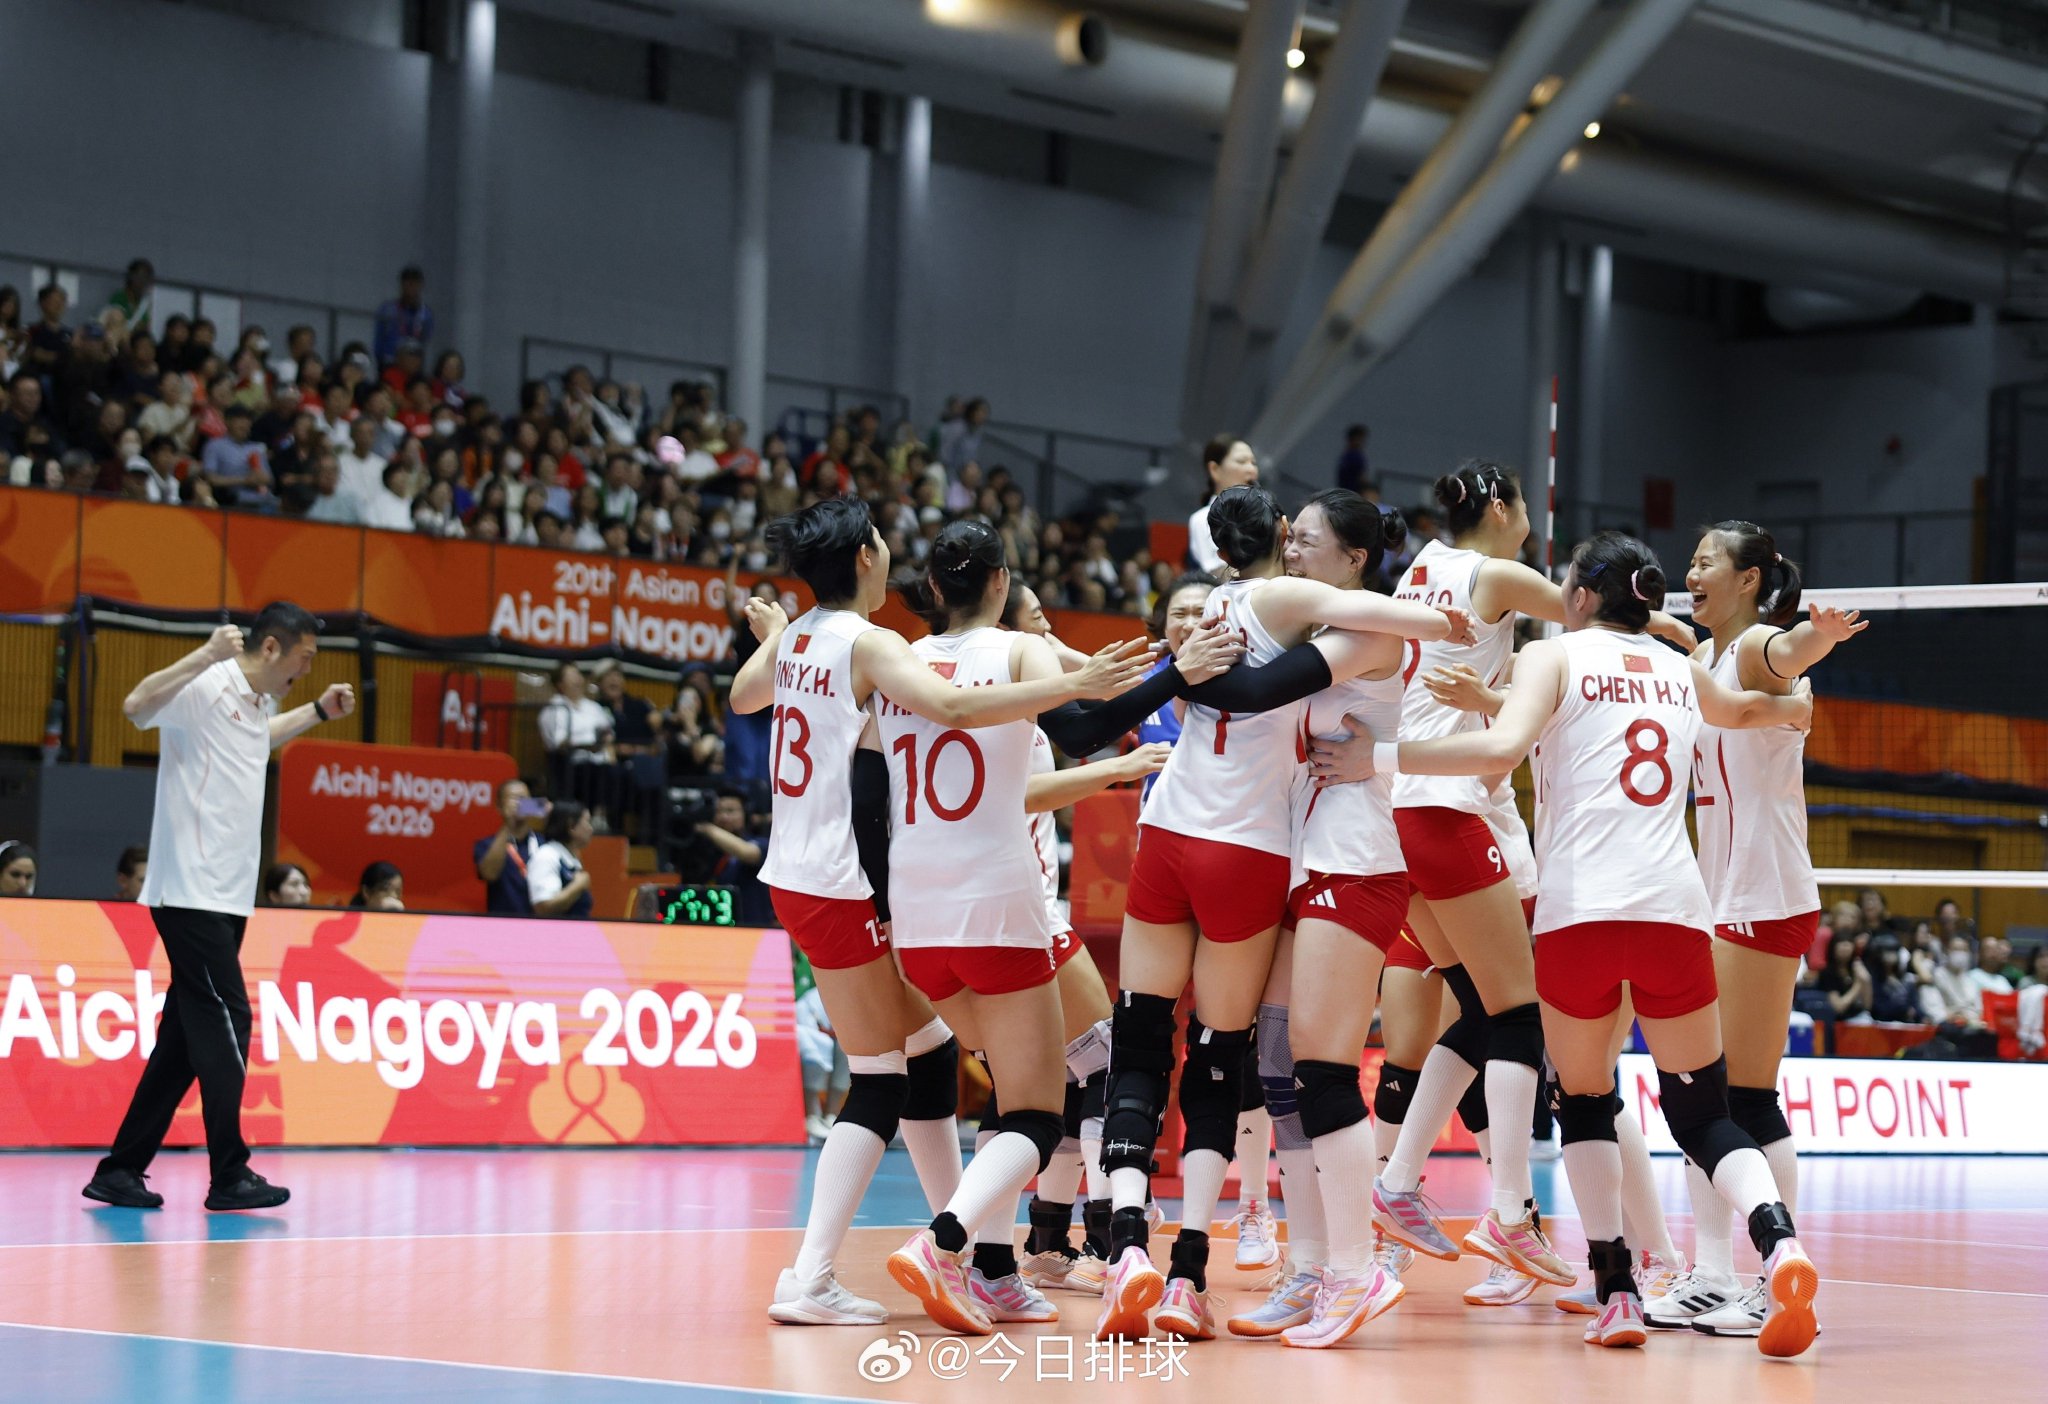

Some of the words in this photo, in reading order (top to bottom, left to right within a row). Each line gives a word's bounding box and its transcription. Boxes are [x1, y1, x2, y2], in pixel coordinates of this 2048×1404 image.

[626, 568, 699, 606] Asian
[704, 578, 798, 616] Gas
[490, 591, 734, 662] Aichi-Nagoy
[796, 663, 835, 698] Y.H.
[1581, 675, 1647, 704] CHEN
[1653, 680, 1693, 712] H.Y.
[773, 704, 813, 797] 13
[893, 729, 985, 824] 10
[1619, 718, 1672, 807] 8
[310, 762, 492, 813] Aichi-Nagoya
[367, 803, 435, 837] 2026
[1487, 845, 1502, 873] 9
[580, 987, 757, 1069] 2026
[1833, 1078, 1971, 1138] POINT
